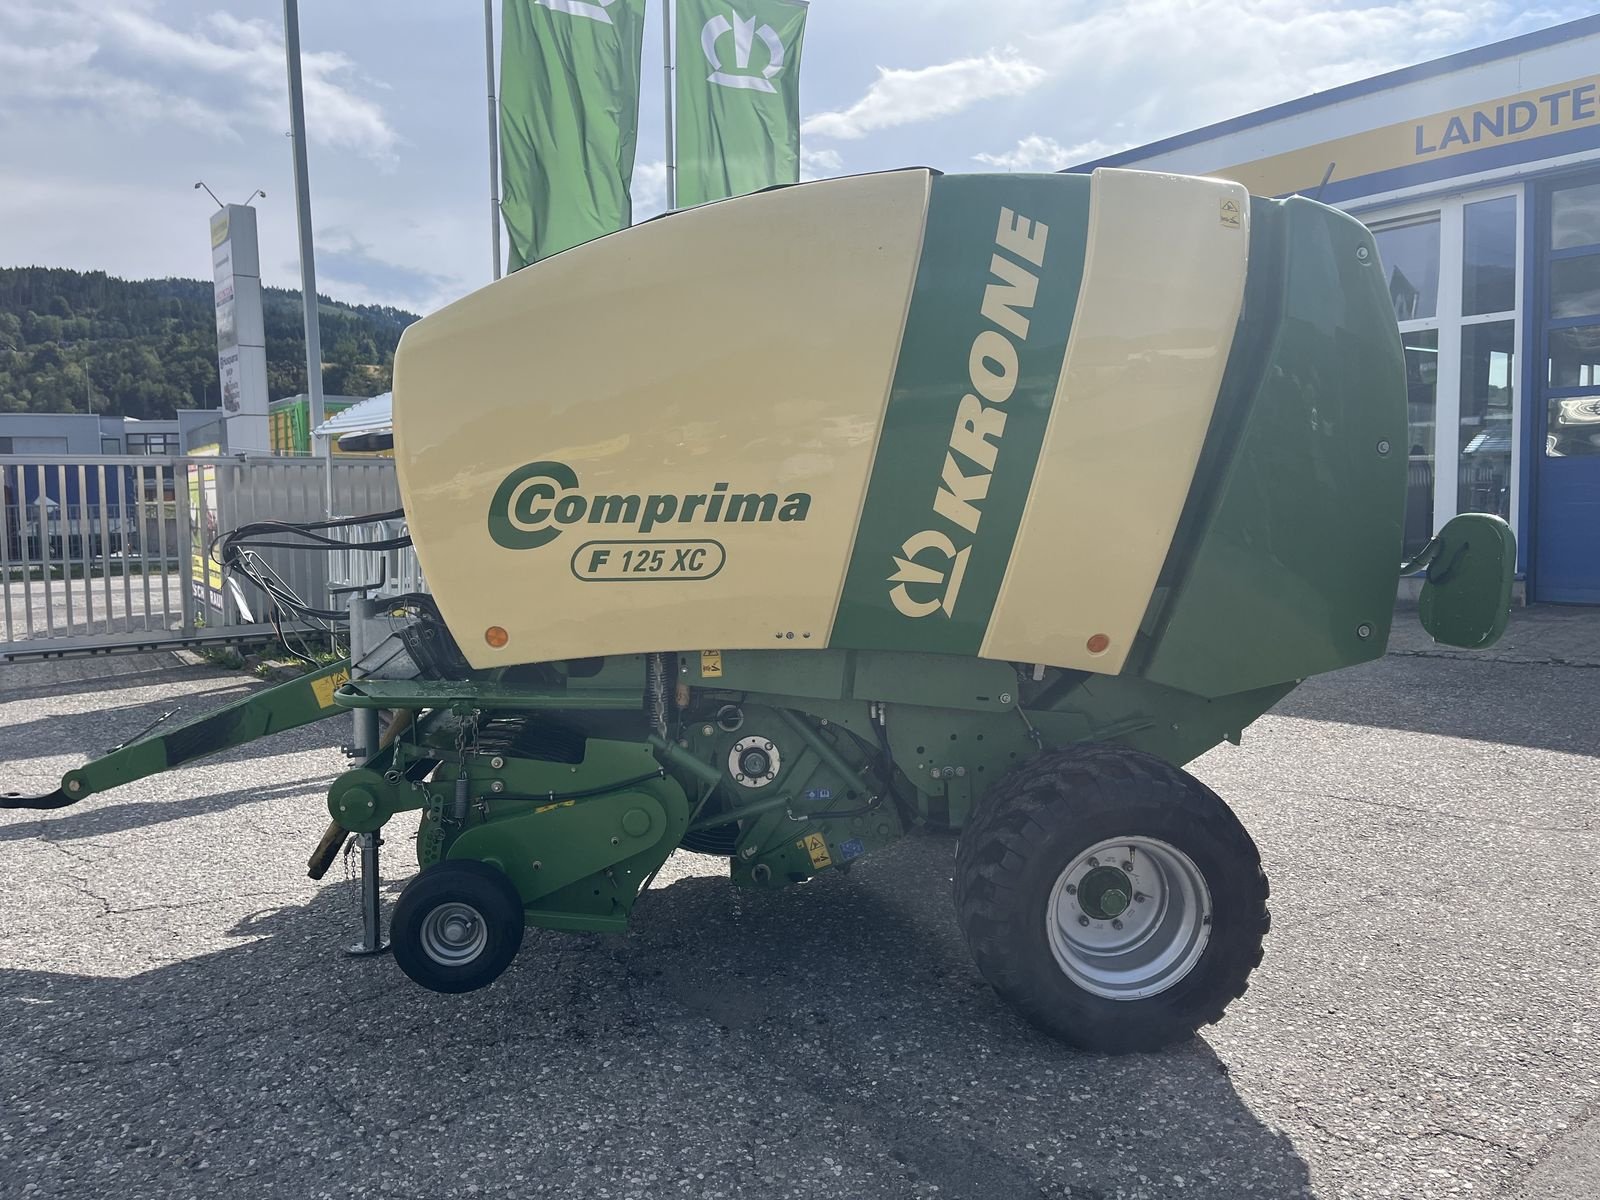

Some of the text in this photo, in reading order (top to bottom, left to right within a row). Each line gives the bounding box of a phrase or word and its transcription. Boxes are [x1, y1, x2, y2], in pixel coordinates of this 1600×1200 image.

[1415, 84, 1600, 155] LANDTE
[933, 206, 1049, 535] KRONE
[588, 548, 707, 573] F 125 XC
